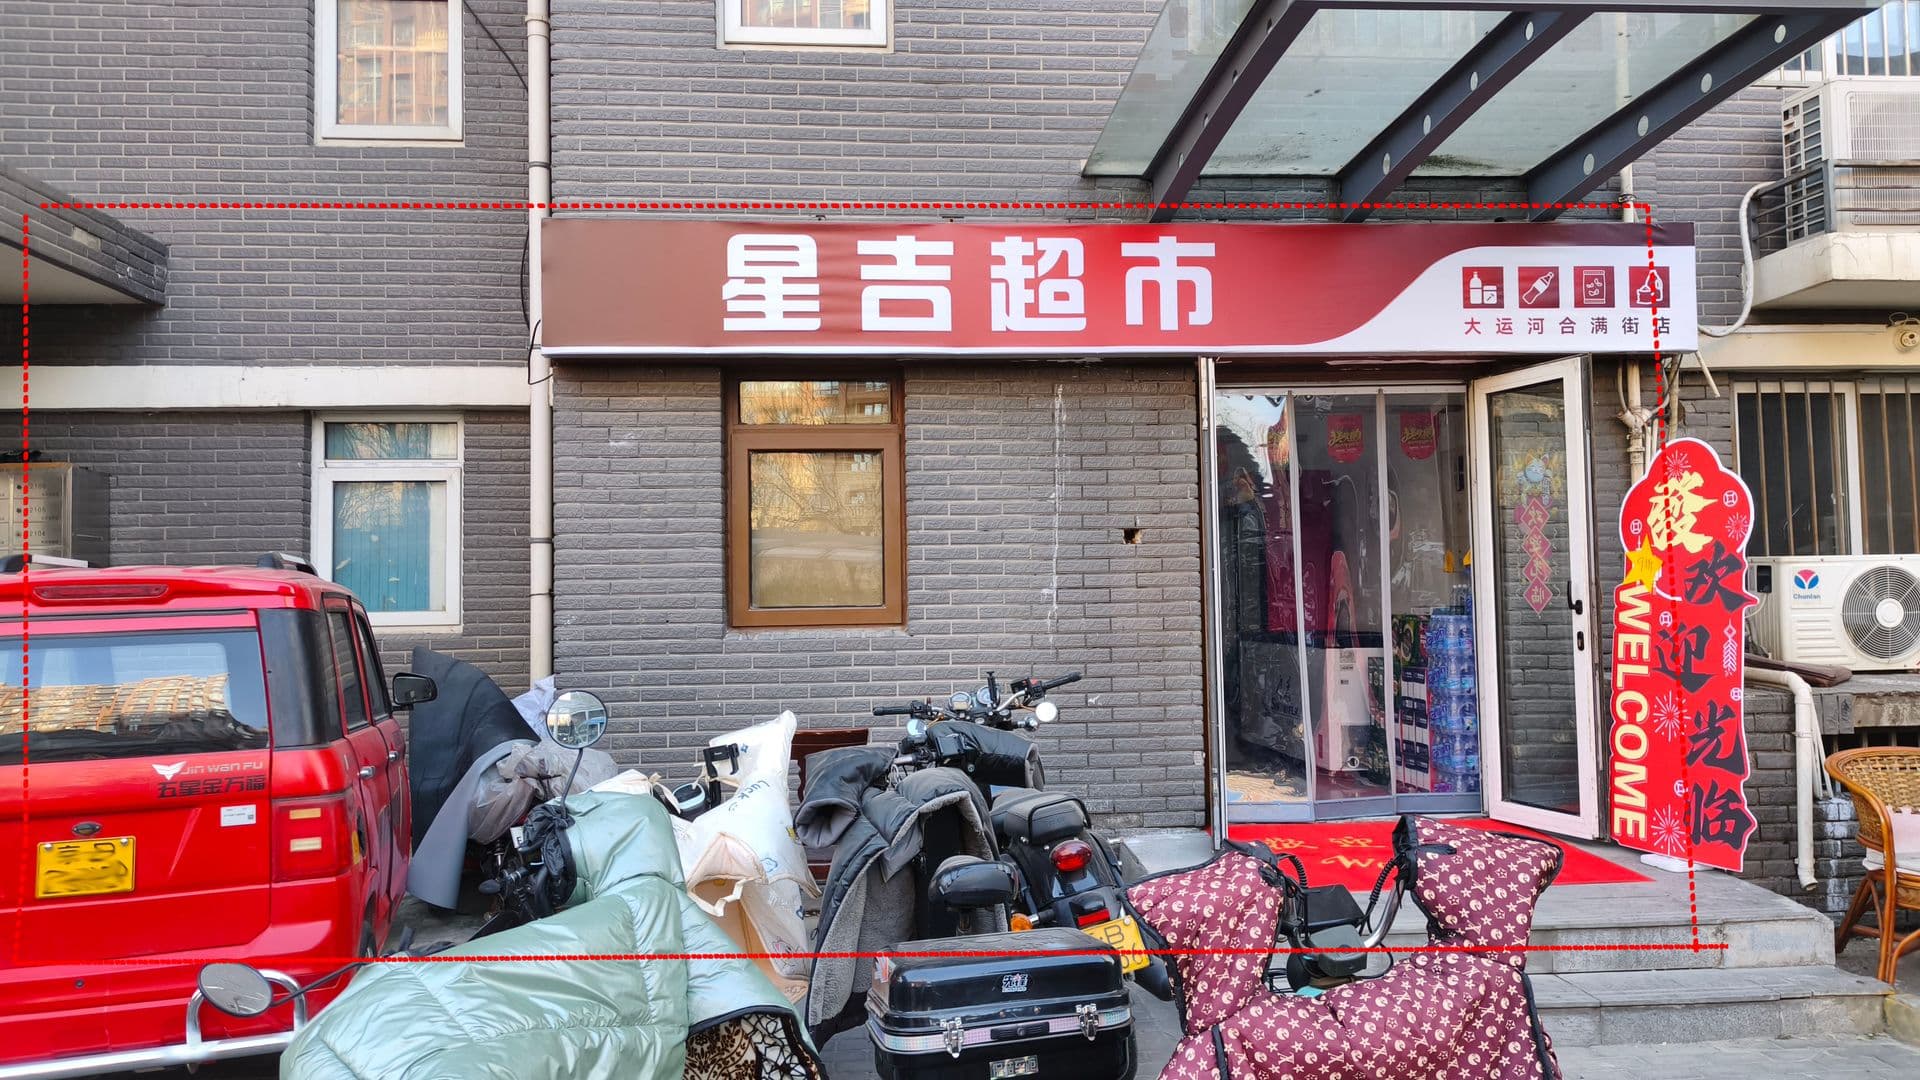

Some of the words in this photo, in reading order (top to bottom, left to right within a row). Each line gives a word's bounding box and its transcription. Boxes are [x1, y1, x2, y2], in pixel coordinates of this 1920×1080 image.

[721, 233, 1217, 332] 星吉超市
[1463, 316, 1672, 336] 大运河合满街店
[1611, 584, 1652, 843] WELCOME
[1653, 540, 1756, 850] 欢迎光临
[157, 774, 267, 799] 五星金万福
